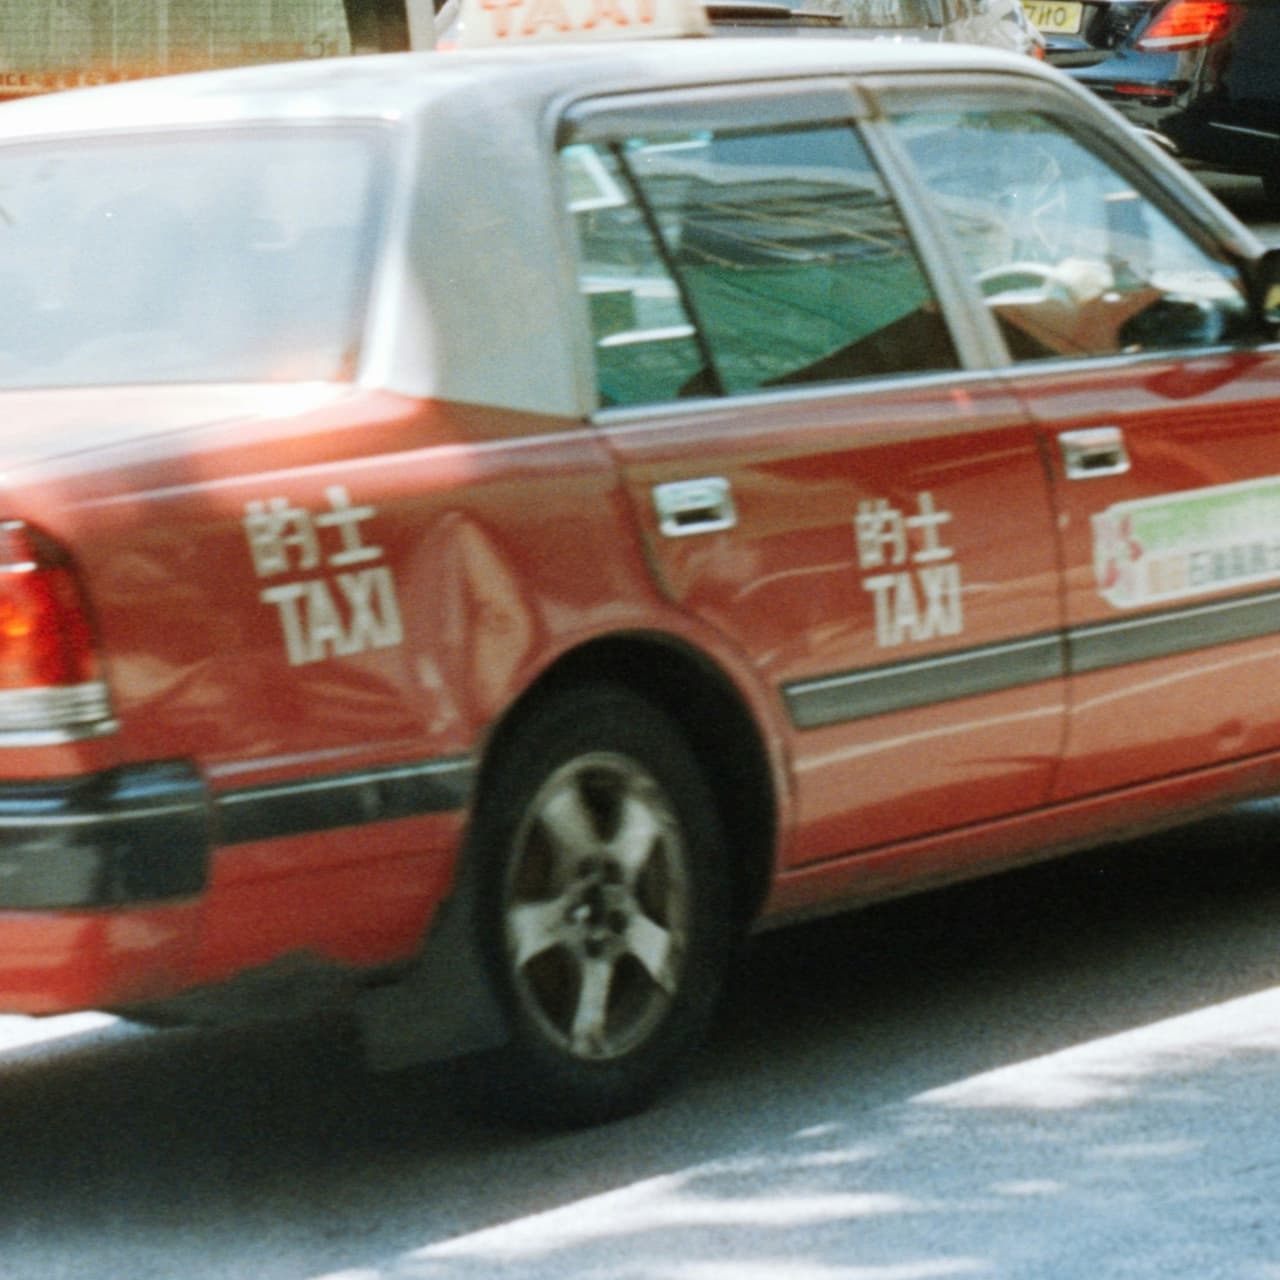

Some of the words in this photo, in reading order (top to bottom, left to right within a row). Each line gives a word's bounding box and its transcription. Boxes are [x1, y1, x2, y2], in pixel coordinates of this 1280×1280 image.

[242, 485, 384, 578] 的士
[854, 491, 955, 570] 的士
[260, 566, 404, 666] TAXI
[862, 564, 964, 648] TAXI
